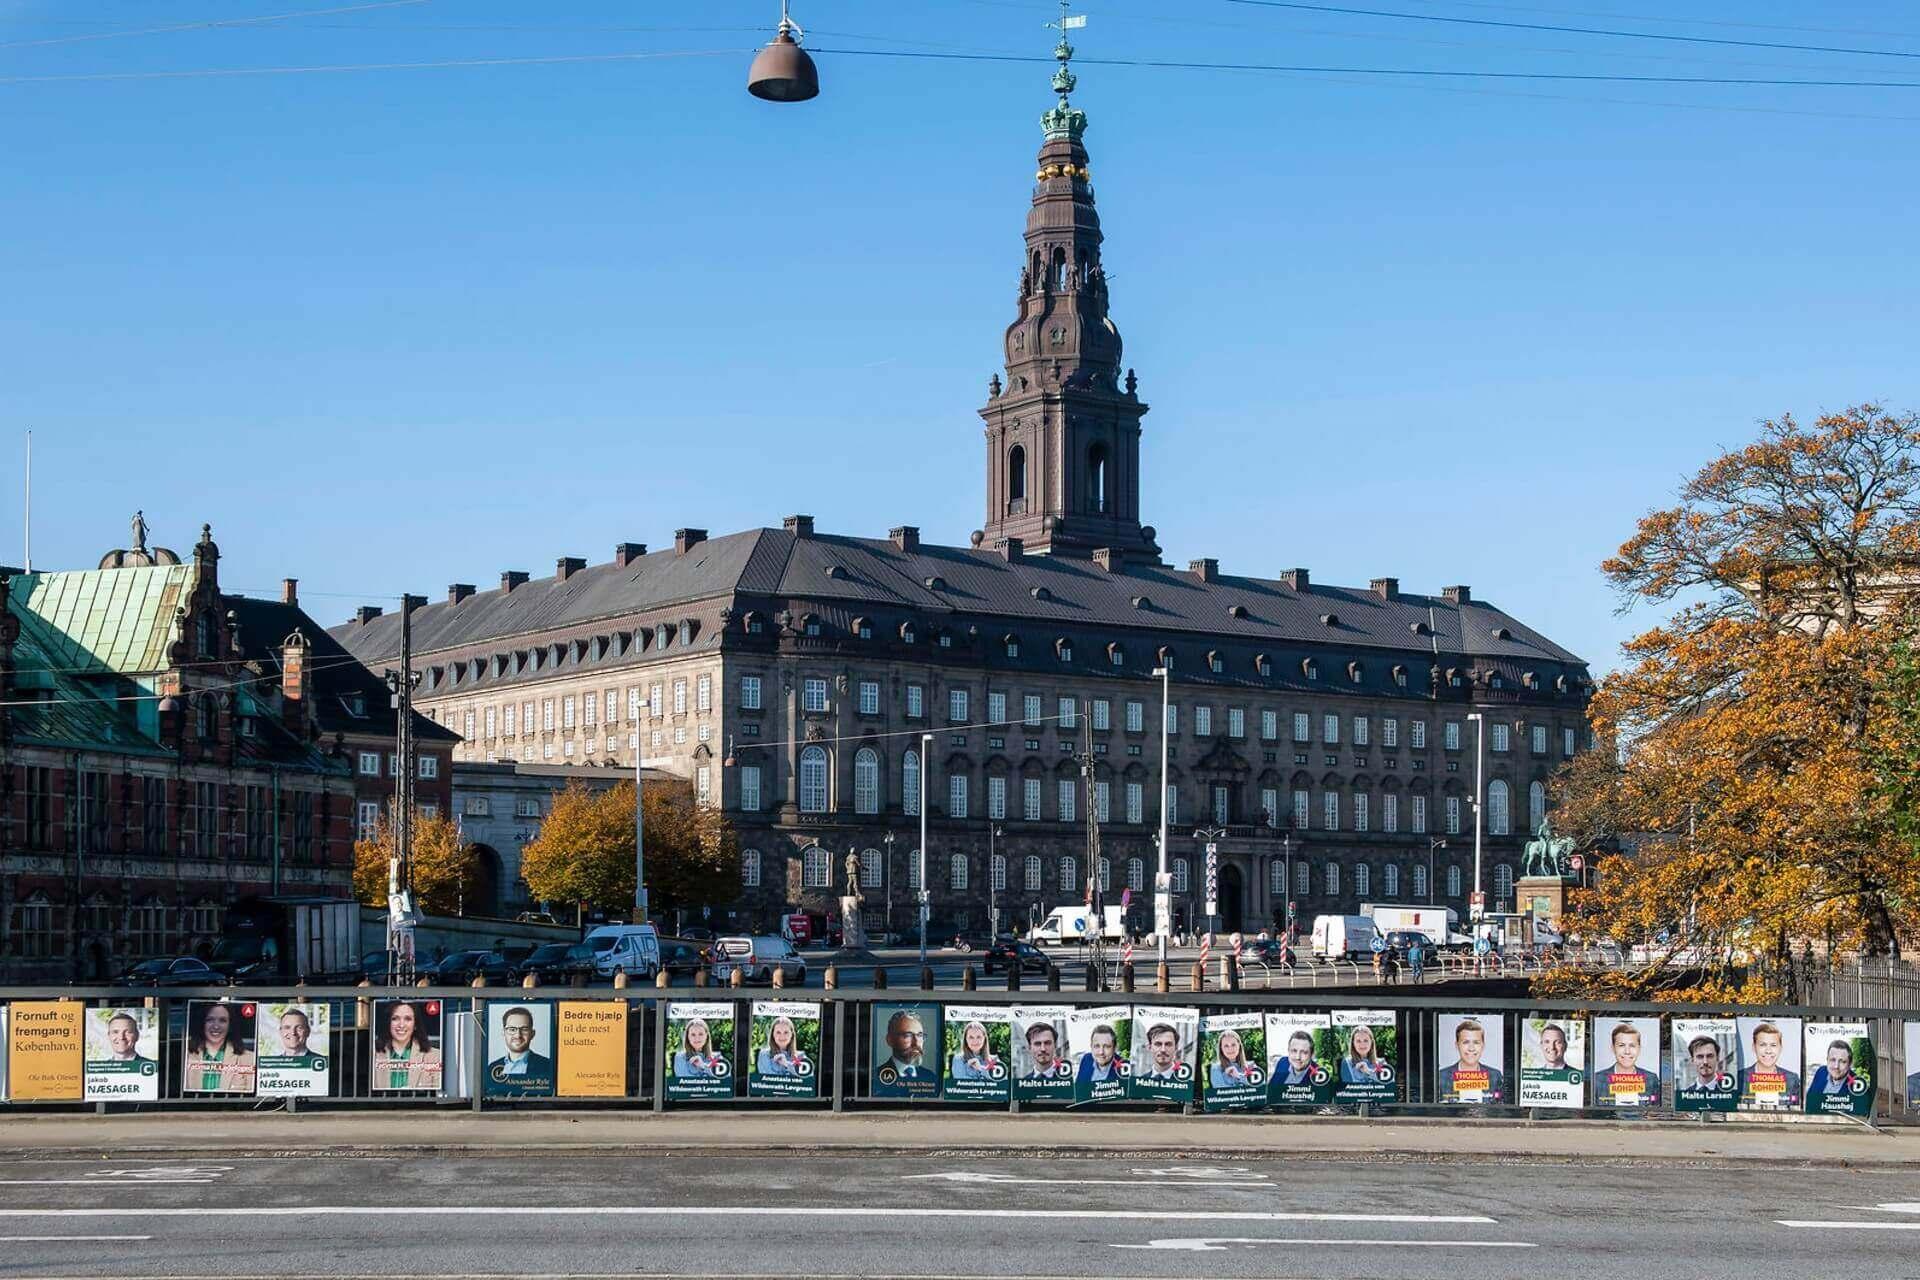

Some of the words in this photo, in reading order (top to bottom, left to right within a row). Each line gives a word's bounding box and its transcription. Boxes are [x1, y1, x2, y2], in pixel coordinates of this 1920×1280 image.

[16, 1011, 58, 1021] Fornuft
[61, 1013, 74, 1023] og
[564, 1011, 593, 1019] Bedre
[596, 1011, 623, 1021] hjælp
[16, 1027, 70, 1038] fremgang
[73, 1025, 77, 1035] i
[564, 1025, 574, 1033] til
[576, 1025, 587, 1033] de
[16, 1041, 80, 1052] København.
[715, 1064, 727, 1075] D
[799, 1062, 811, 1074] D
[993, 1066, 1004, 1077] D
[1061, 1065, 1071, 1076] D
[1121, 1064, 1131, 1076] D
[1179, 1067, 1190, 1077] D
[1250, 1072, 1261, 1082] D
[1316, 1071, 1327, 1082] D
[1380, 1068, 1392, 1080] D
[1455, 1072, 1487, 1080] THOMAS
[1571, 1074, 1579, 1082] C
[1751, 1074, 1785, 1082] THOMAS
[260, 1080, 311, 1088] NÆSAGER
[1095, 1080, 1119, 1090] Jimmi
[1136, 1079, 1159, 1087] Malte
[1161, 1080, 1188, 1089] Larsen
[1456, 1081, 1487, 1089] ROHDEN
[1722, 1076, 1732, 1088] D
[1752, 1083, 1784, 1091] ROHDEN
[1852, 1080, 1865, 1092] D
[88, 1085, 140, 1093] NÆSAGER
[1287, 1085, 1311, 1093] Jimmi
[1612, 1084, 1643, 1092] ROHDEN
[1522, 1092, 1568, 1100] NÆSAGER
[1682, 1092, 1704, 1100] Malte
